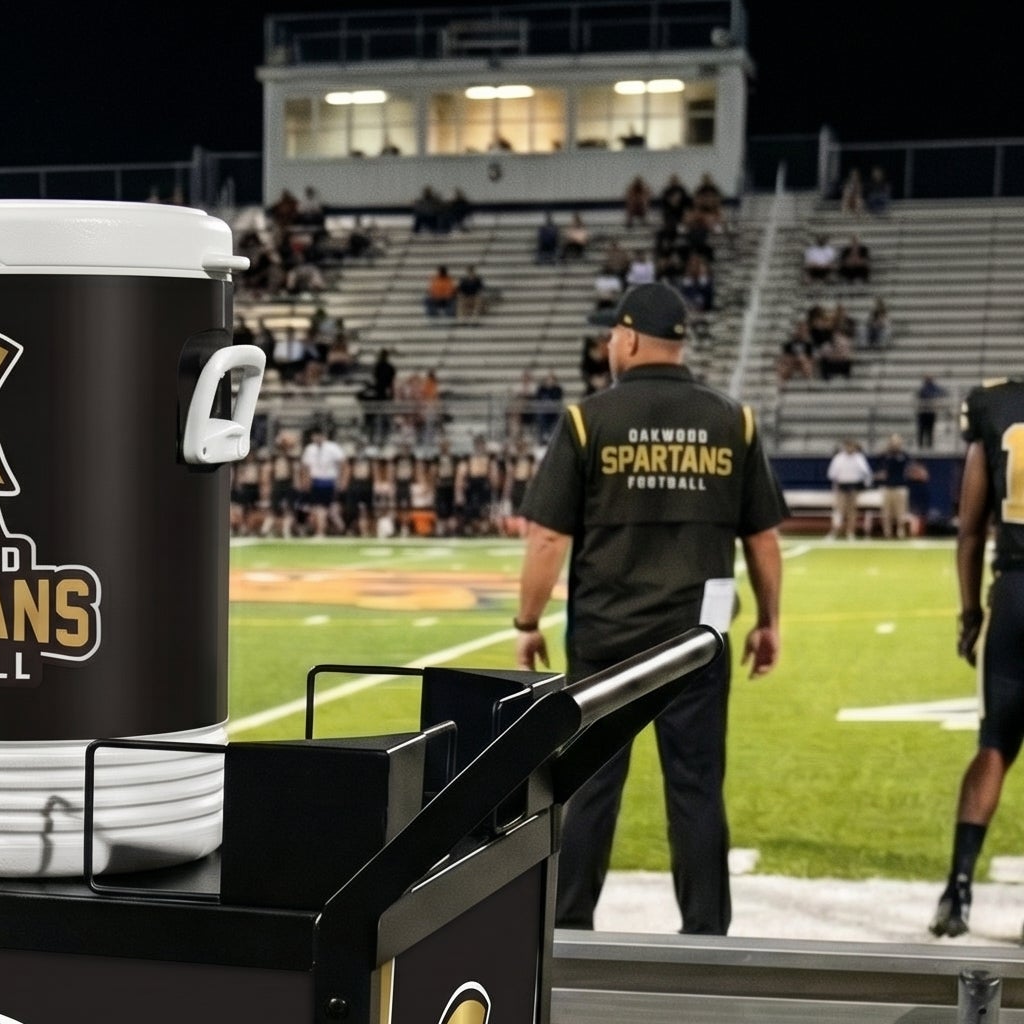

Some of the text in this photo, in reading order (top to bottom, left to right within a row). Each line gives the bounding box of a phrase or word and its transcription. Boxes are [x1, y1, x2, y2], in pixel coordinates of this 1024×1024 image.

[628, 428, 708, 443] OAKWOOD
[601, 445, 733, 476] SPARTANS
[627, 476, 707, 490] FOOTBALL
